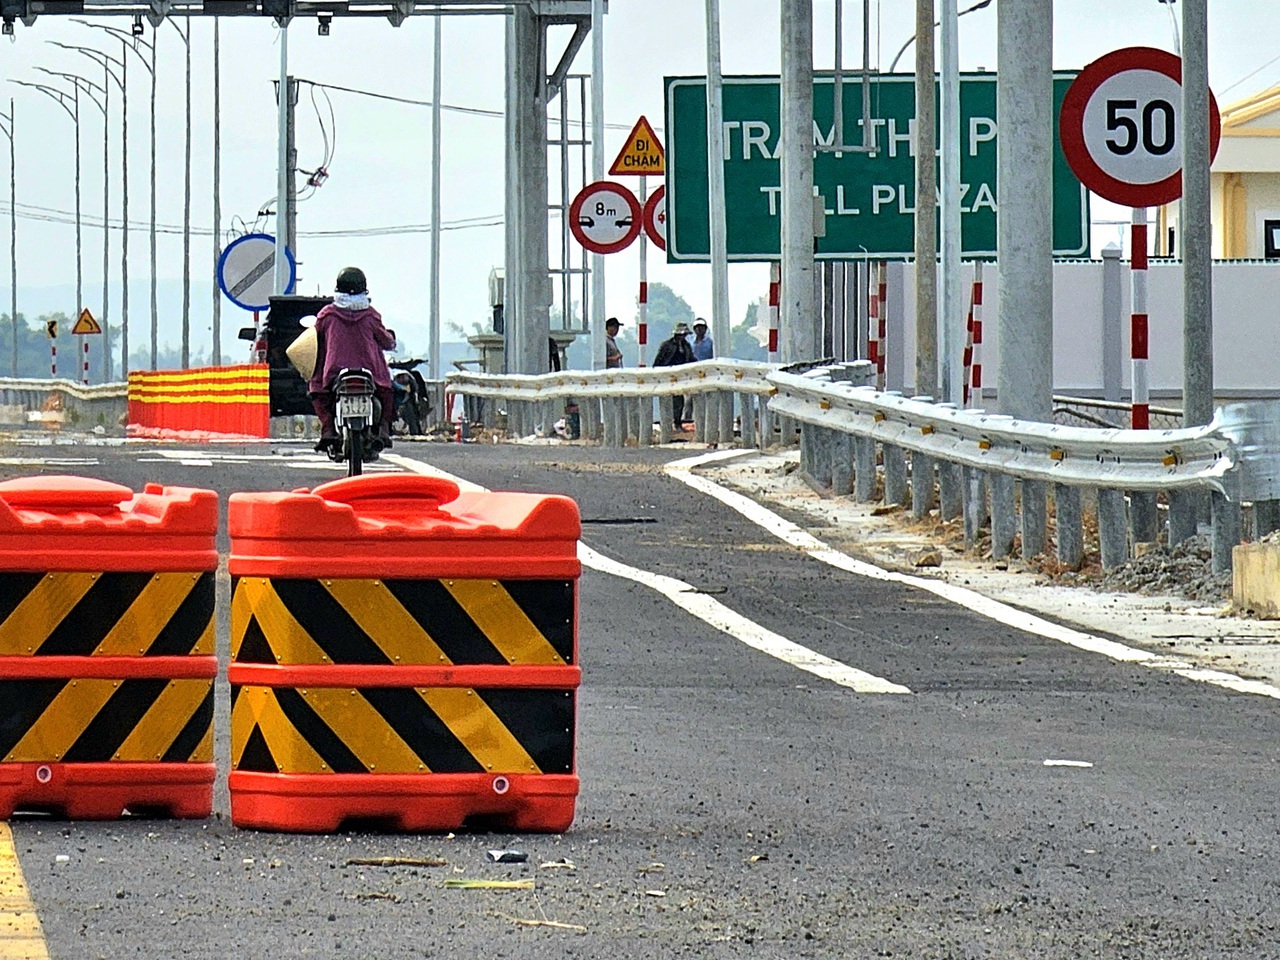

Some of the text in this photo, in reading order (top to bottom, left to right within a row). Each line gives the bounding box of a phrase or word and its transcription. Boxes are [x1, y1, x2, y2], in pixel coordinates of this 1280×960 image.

[723, 118, 842, 160] TRM
[1105, 99, 1175, 155] 50
[636, 140, 649, 151] ĐI
[624, 152, 660, 170] CHẬM
[595, 202, 616, 216] 8 m
[760, 183, 997, 215] TL PLA
